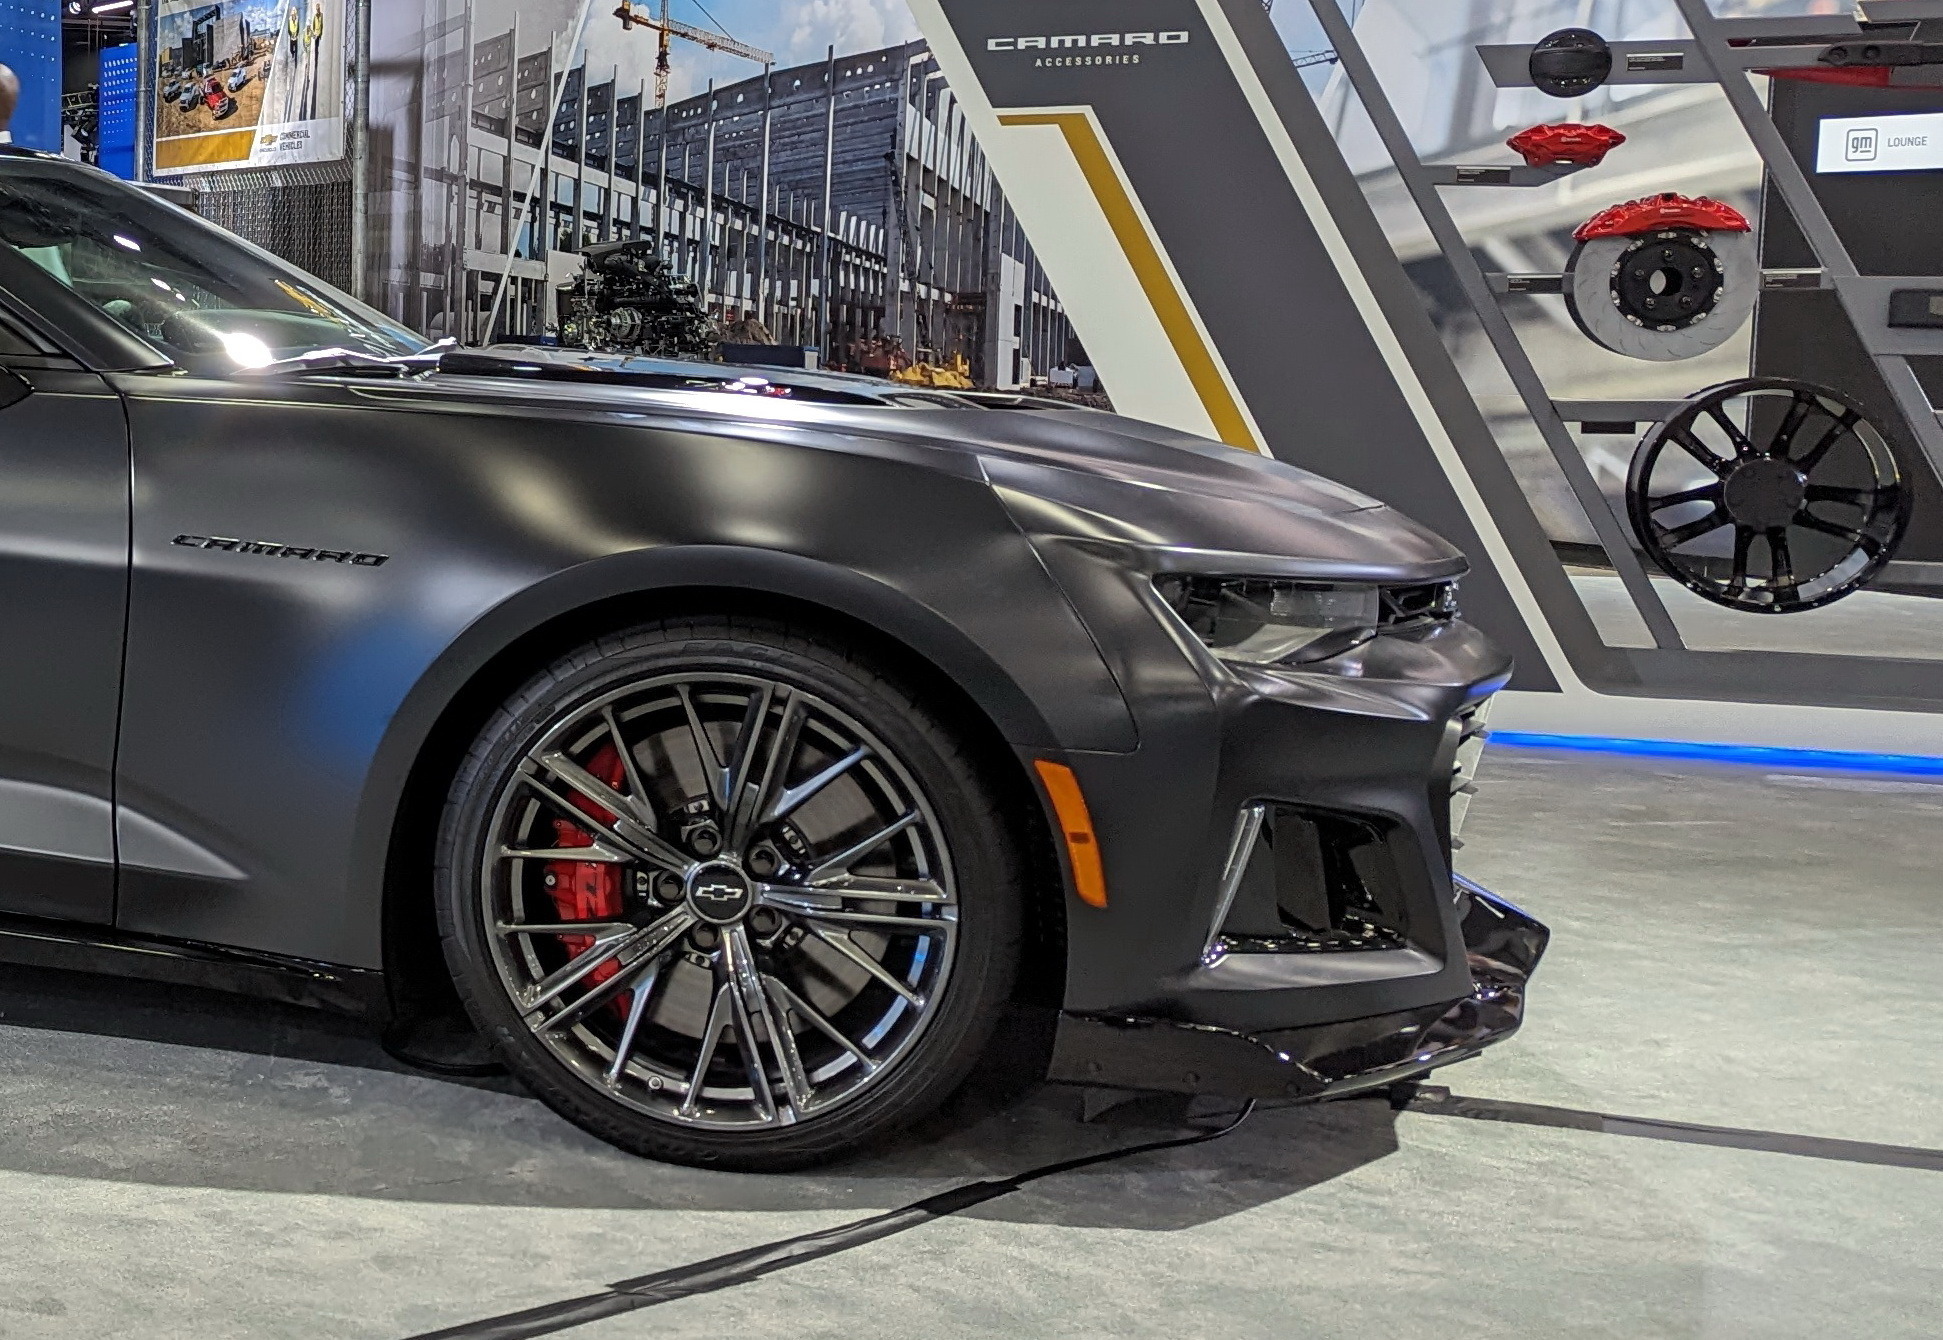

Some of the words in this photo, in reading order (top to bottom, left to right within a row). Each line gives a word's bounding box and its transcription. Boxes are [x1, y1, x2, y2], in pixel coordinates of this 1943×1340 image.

[986, 30, 1190, 51] CAMARO
[1034, 54, 1141, 68] ACCESSORIES
[1851, 136, 1873, 154] gm
[1887, 136, 1928, 148] LOUNGE
[170, 533, 390, 567] CAMARO
